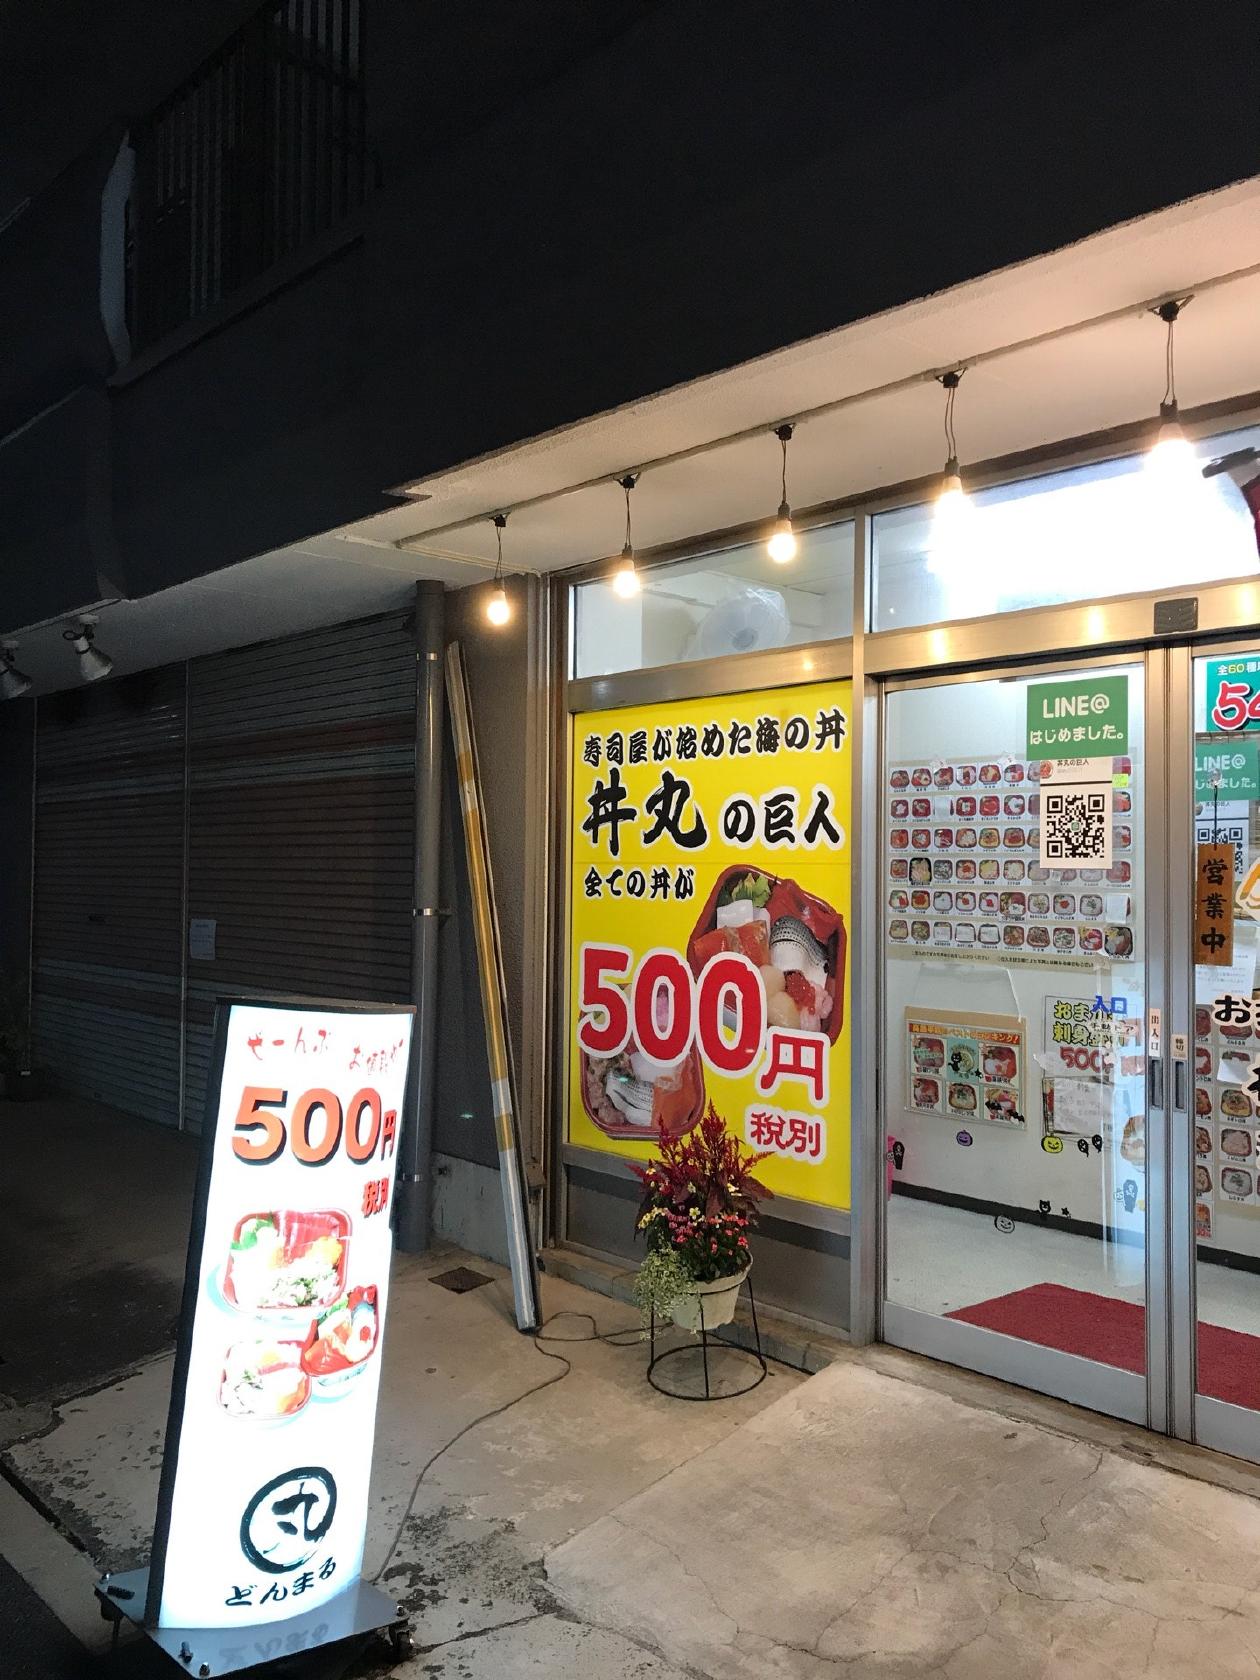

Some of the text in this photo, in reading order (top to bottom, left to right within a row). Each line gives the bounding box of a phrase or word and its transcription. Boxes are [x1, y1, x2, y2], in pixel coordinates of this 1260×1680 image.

[1043, 694, 1110, 719] LINE@
[584, 709, 846, 766] 寿司屋が始めた海の丼
[1030, 723, 1124, 745] はじめました。
[584, 867, 694, 899] 全ての丼が
[1203, 859, 1227, 953] 営業中
[1091, 996, 1127, 1014] 入口
[1151, 1015, 1160, 1051] 出入口
[232, 1086, 397, 1167] 500円
[749, 1110, 821, 1156] 税別
[225, 1557, 336, 1607] どんまる
